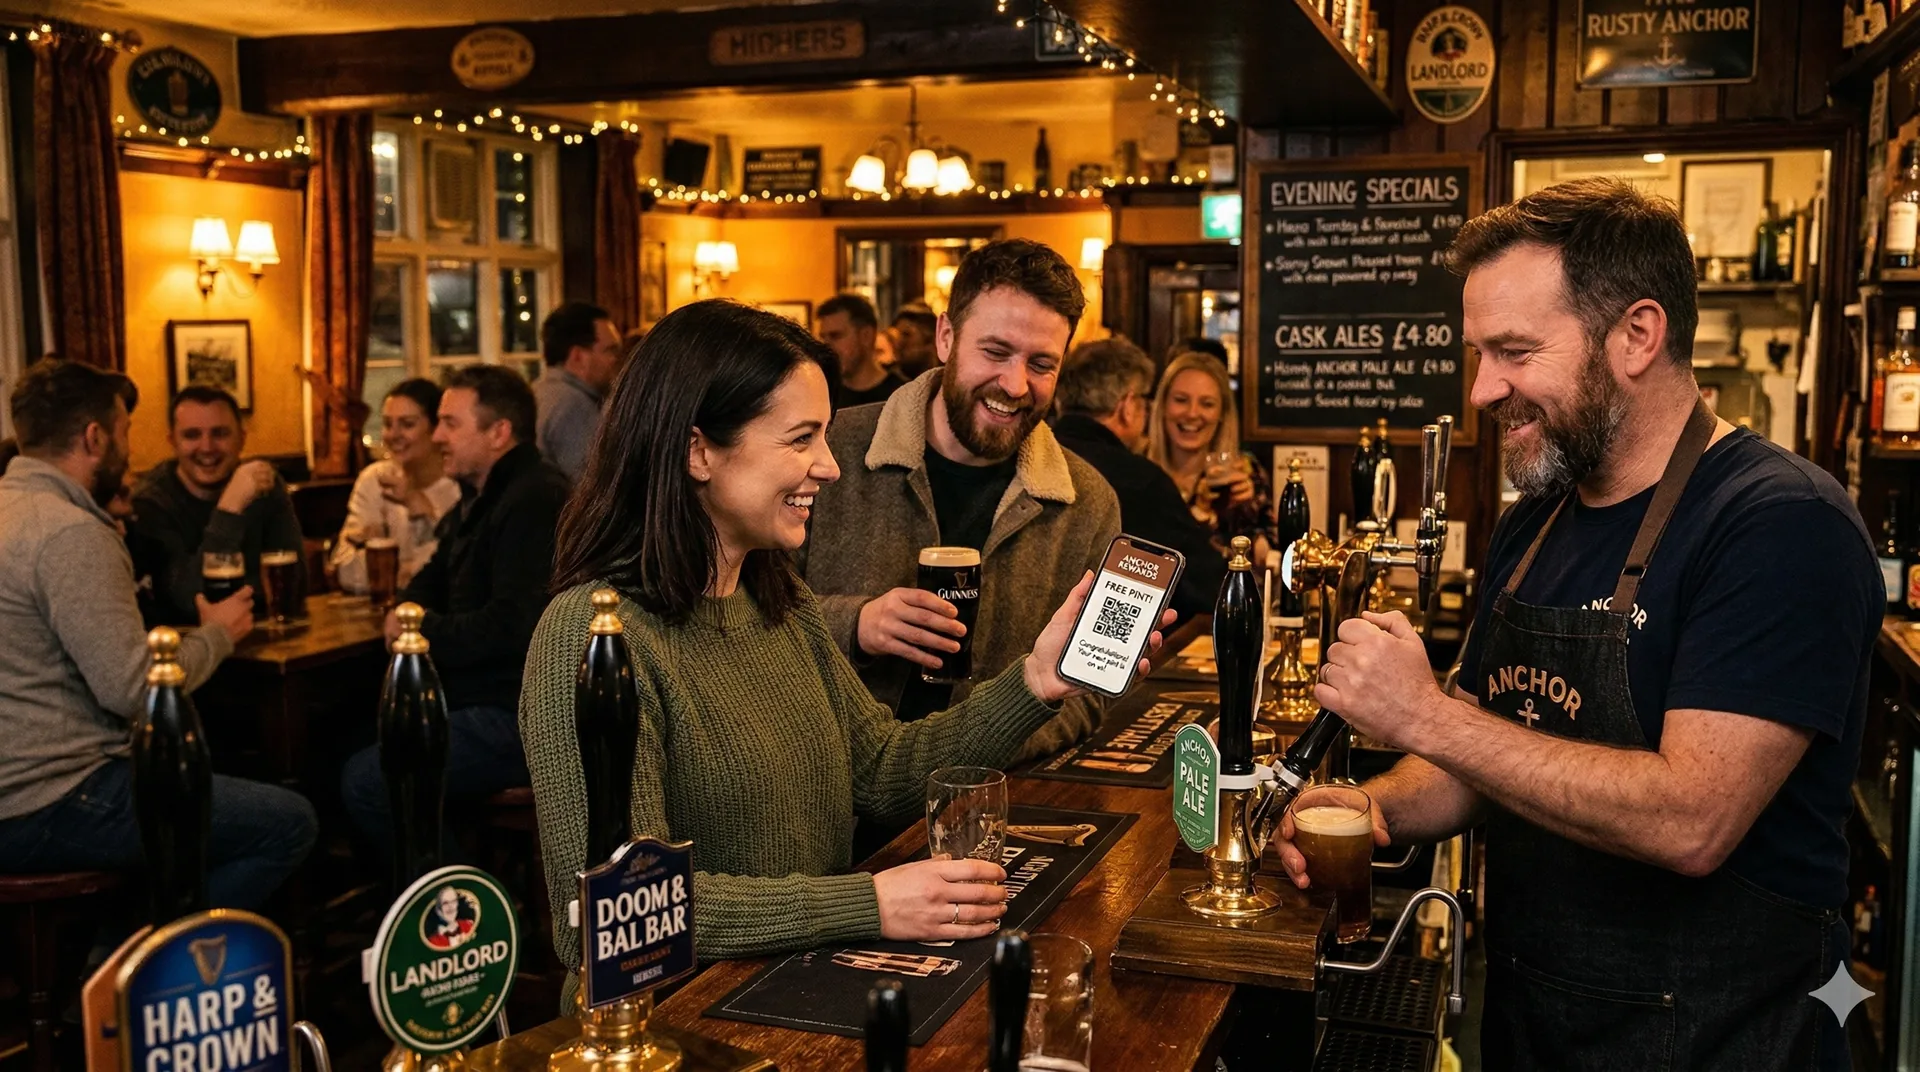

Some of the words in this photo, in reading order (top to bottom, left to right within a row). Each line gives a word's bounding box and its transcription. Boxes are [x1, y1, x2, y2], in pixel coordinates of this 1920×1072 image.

[1587, 11, 1658, 38] RUSTY
[1660, 7, 1750, 33] ANCHOR
[1411, 62, 1488, 81] LANDLORD
[1270, 179, 1358, 206] EVENING
[1366, 176, 1460, 202] SPECIALS
[1275, 324, 1328, 348] CASK
[1333, 324, 1384, 348] ALES
[1392, 321, 1453, 350] £4.80
[1117, 560, 1159, 580] REWARDS
[1122, 554, 1160, 571] ANCHOR
[937, 587, 979, 600] GUINNESS
[1105, 580, 1128, 595] FREE
[1128, 588, 1154, 604] PINT!
[1488, 665, 1582, 721] ANCHOR
[1181, 739, 1211, 768] ANCHOR
[1180, 761, 1210, 795] PALE
[1182, 787, 1206, 817] ALE
[595, 878, 669, 930] DOOM
[670, 873, 688, 904] &
[596, 921, 643, 962] BAL
[645, 904, 688, 945] BAR
[390, 940, 509, 994] LANDLORD
[143, 983, 246, 1047] HARP
[252, 974, 278, 1010] &
[146, 1015, 279, 1072] CROWN
